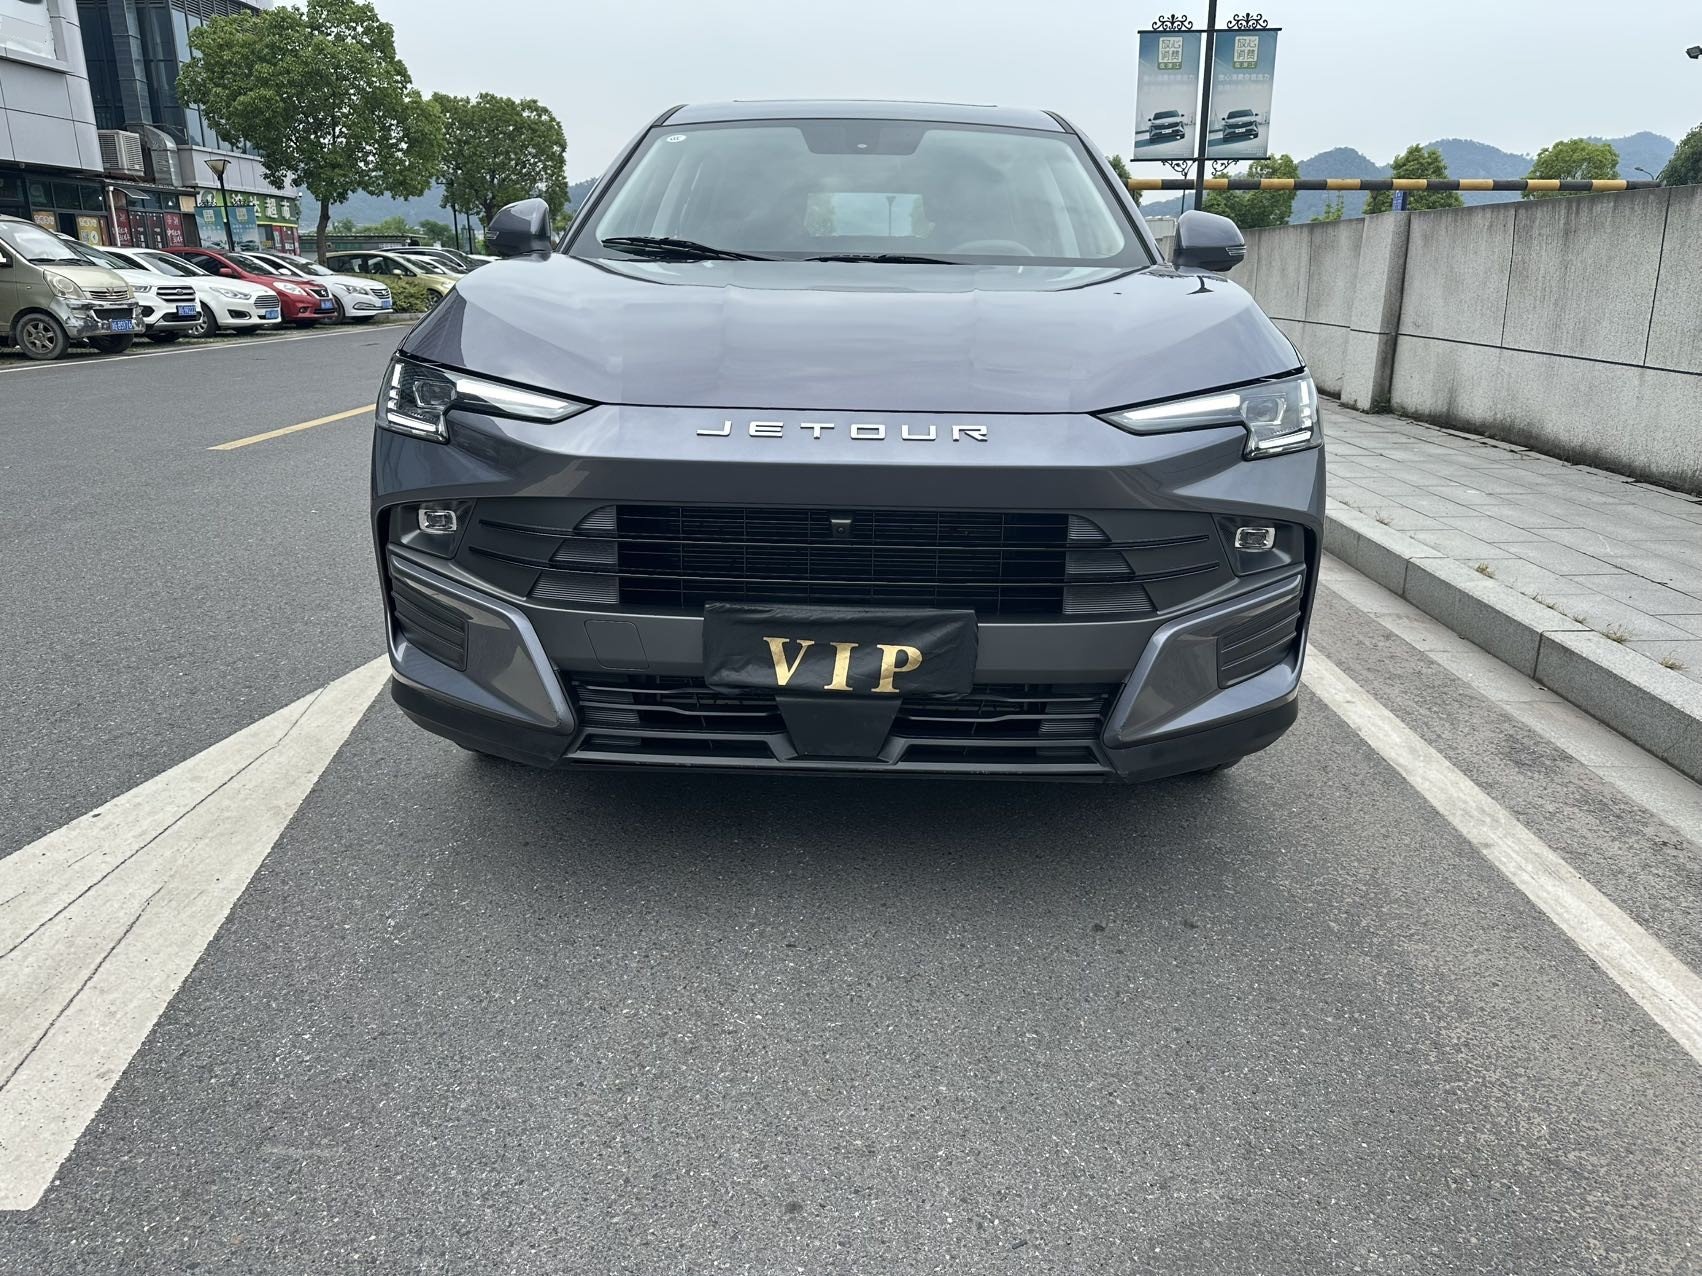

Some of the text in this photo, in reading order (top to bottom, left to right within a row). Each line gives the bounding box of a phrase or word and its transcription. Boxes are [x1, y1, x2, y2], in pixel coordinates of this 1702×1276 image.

[1161, 39, 1181, 49] 放心
[1237, 38, 1257, 49] 放心
[696, 420, 989, 442] JETOUR
[762, 636, 924, 693] VIP
